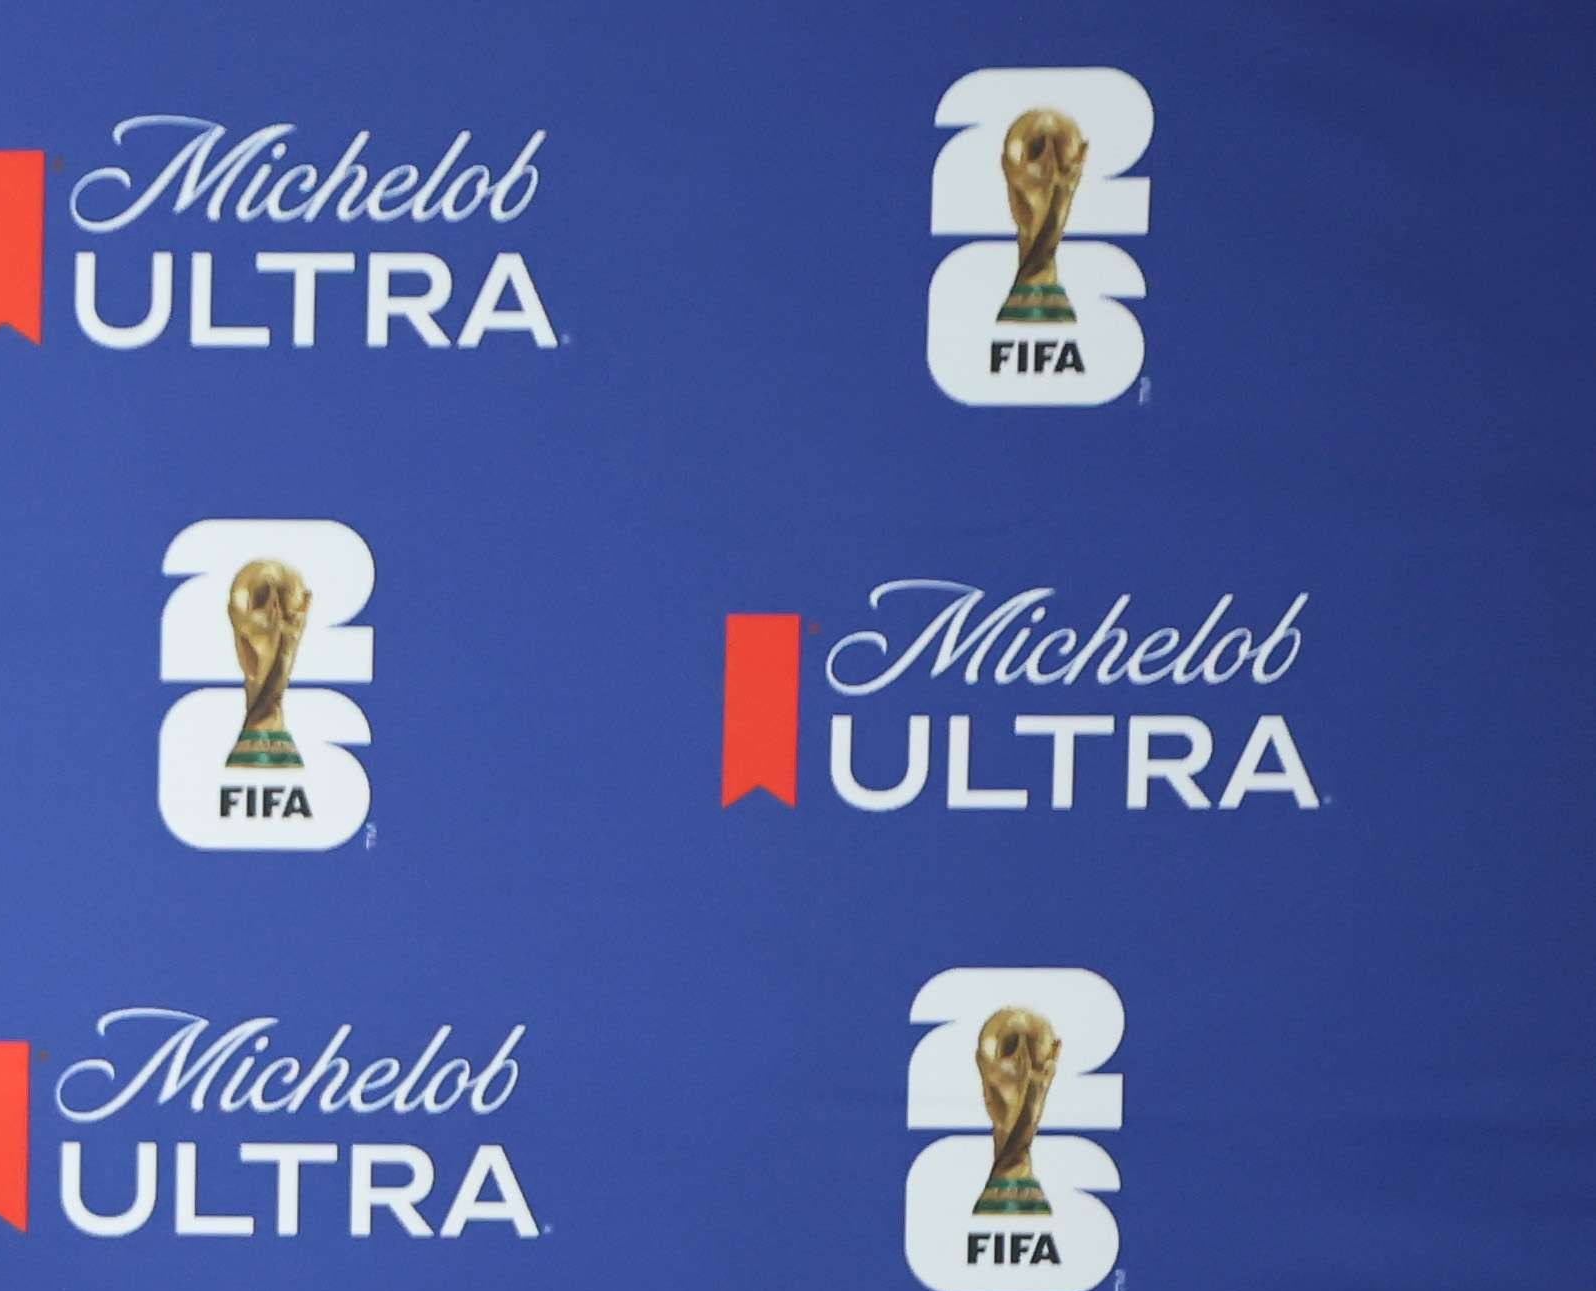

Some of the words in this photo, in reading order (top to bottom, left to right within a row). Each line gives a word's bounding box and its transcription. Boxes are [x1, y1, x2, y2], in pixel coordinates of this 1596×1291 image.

[70, 115, 546, 233] Michelob
[74, 251, 558, 350] ULTRA
[991, 340, 1084, 373] FIFA
[825, 579, 1308, 696] Michelob
[221, 788, 311, 817] FIFA
[830, 715, 1319, 812] ULTRA
[55, 1008, 525, 1123] Michelob
[59, 1141, 539, 1238] ULTRA
[968, 1234, 1060, 1264] FIFA
